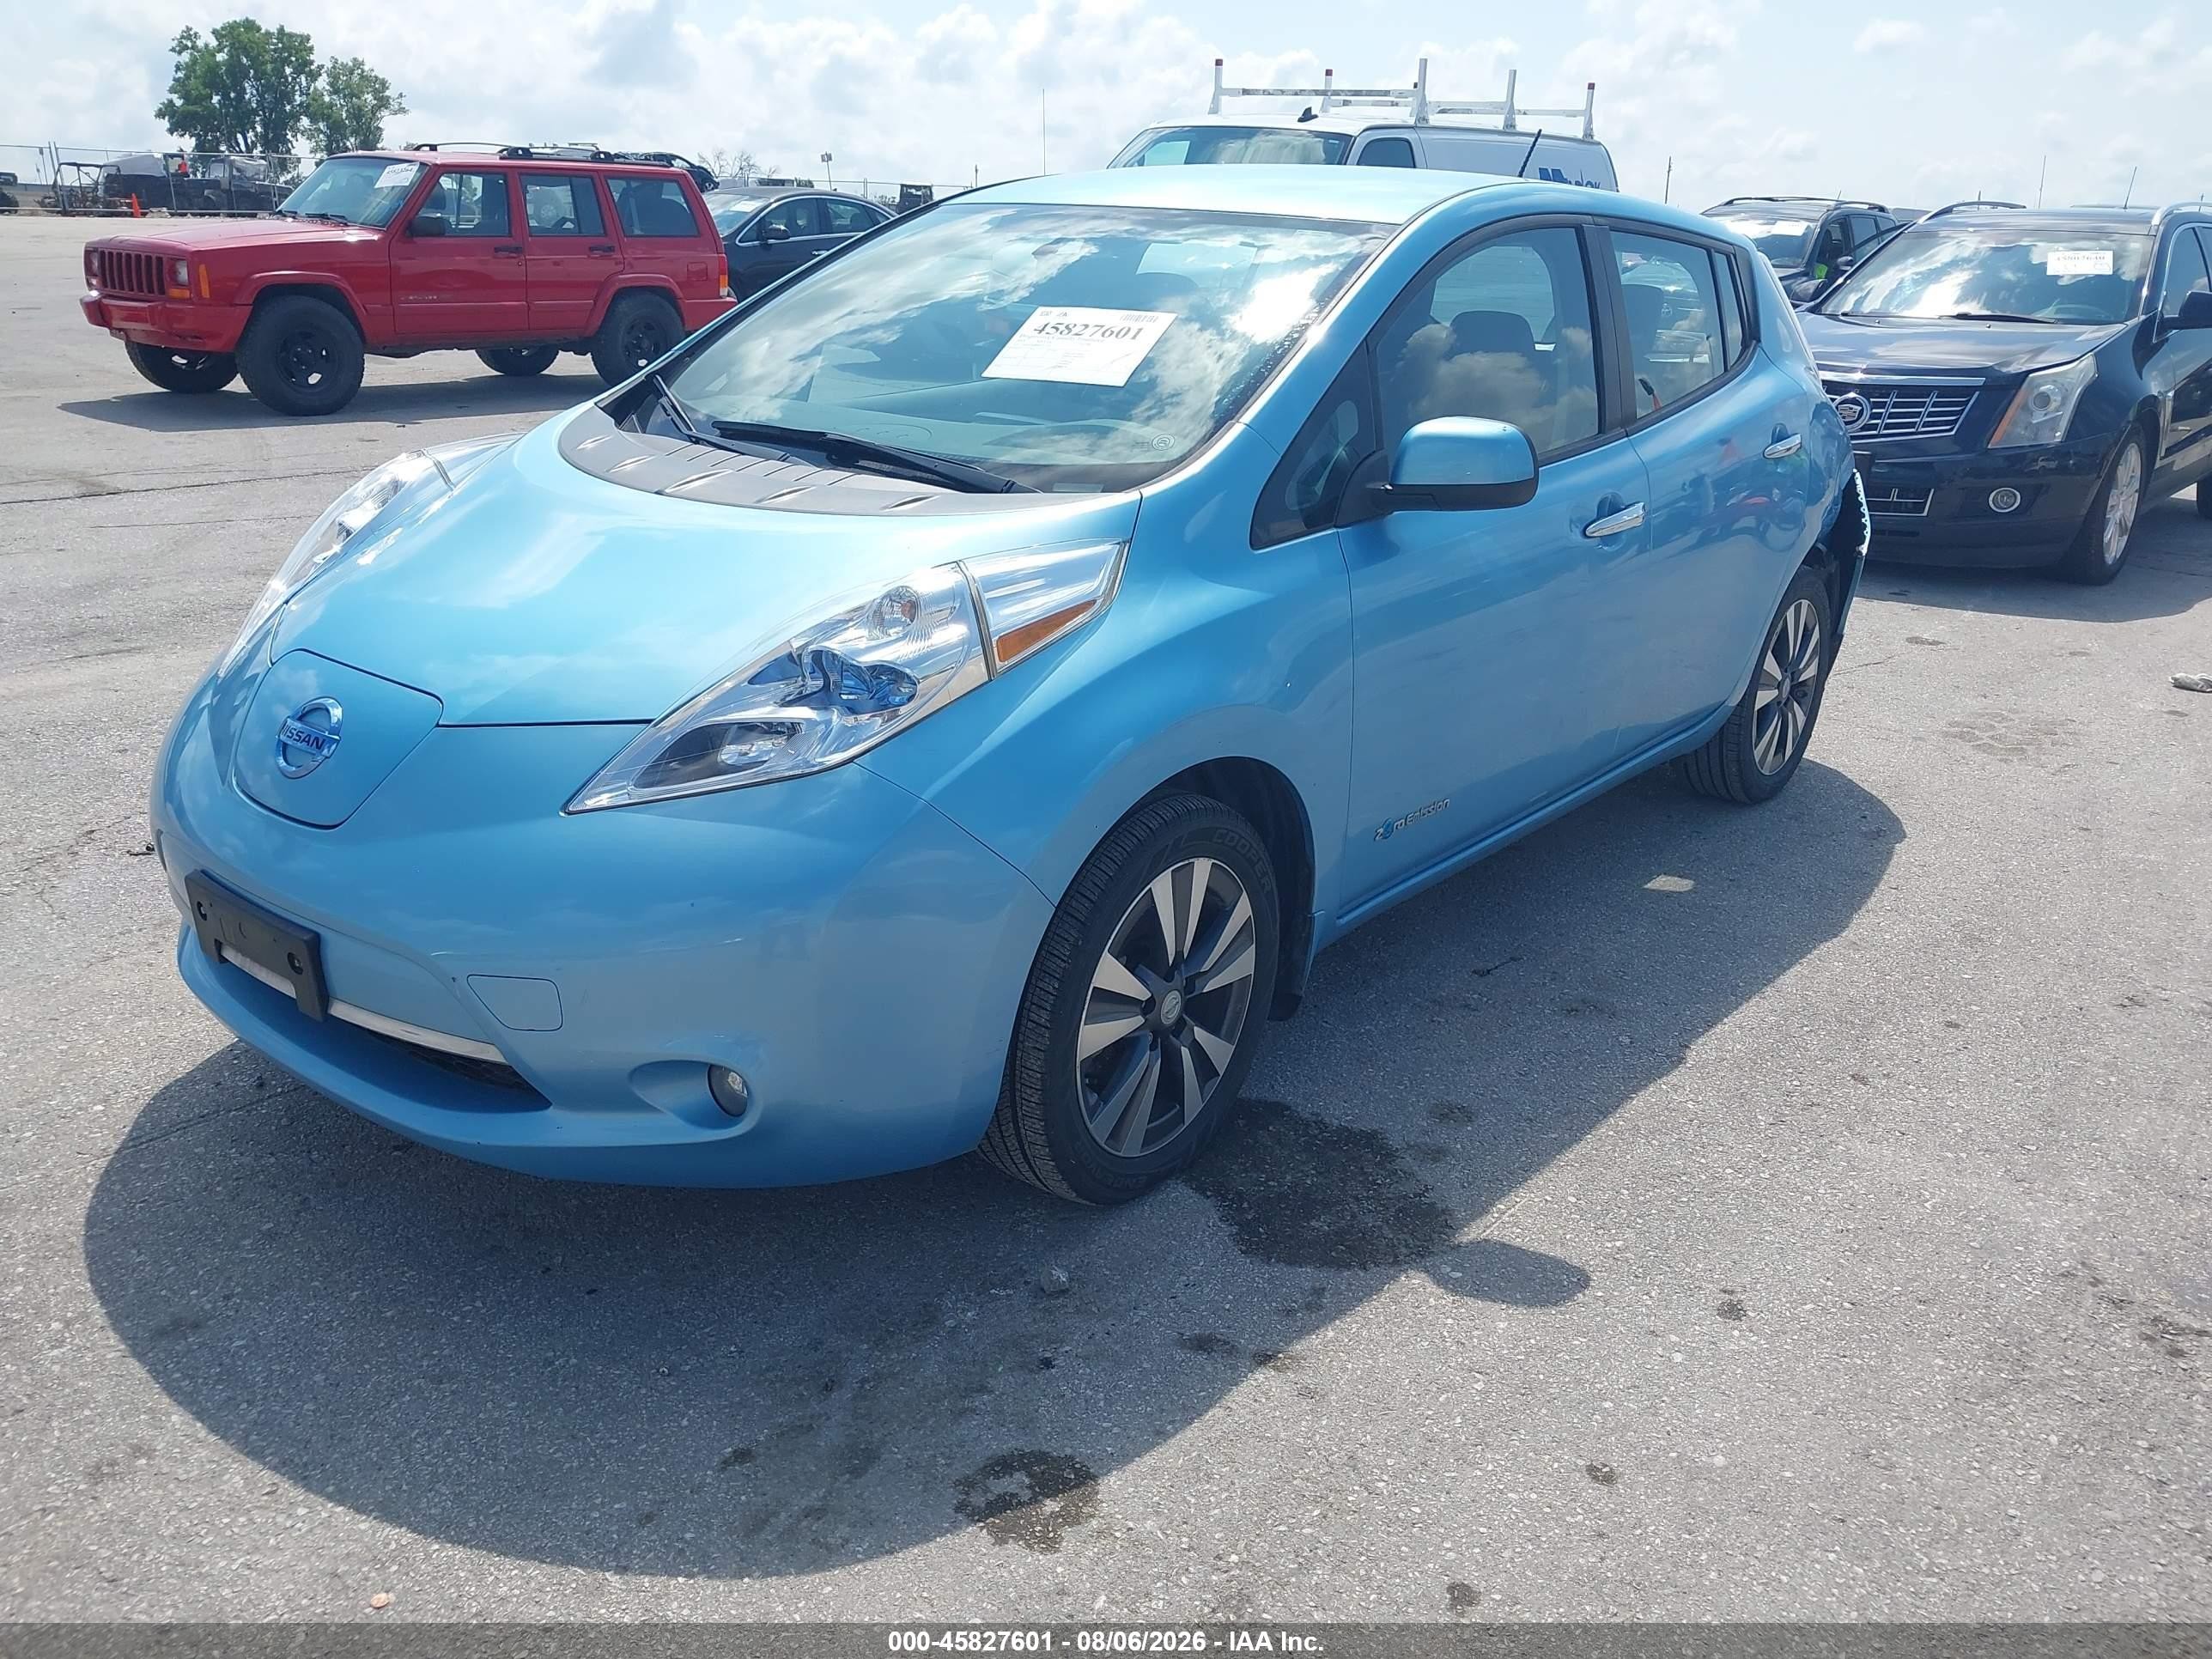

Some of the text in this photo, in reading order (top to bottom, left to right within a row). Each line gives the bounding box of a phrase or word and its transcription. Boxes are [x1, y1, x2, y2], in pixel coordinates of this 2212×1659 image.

[1033, 321, 1145, 341] 45827601
[281, 720, 325, 750] NISSAN
[1212, 829, 1272, 894] COOPER
